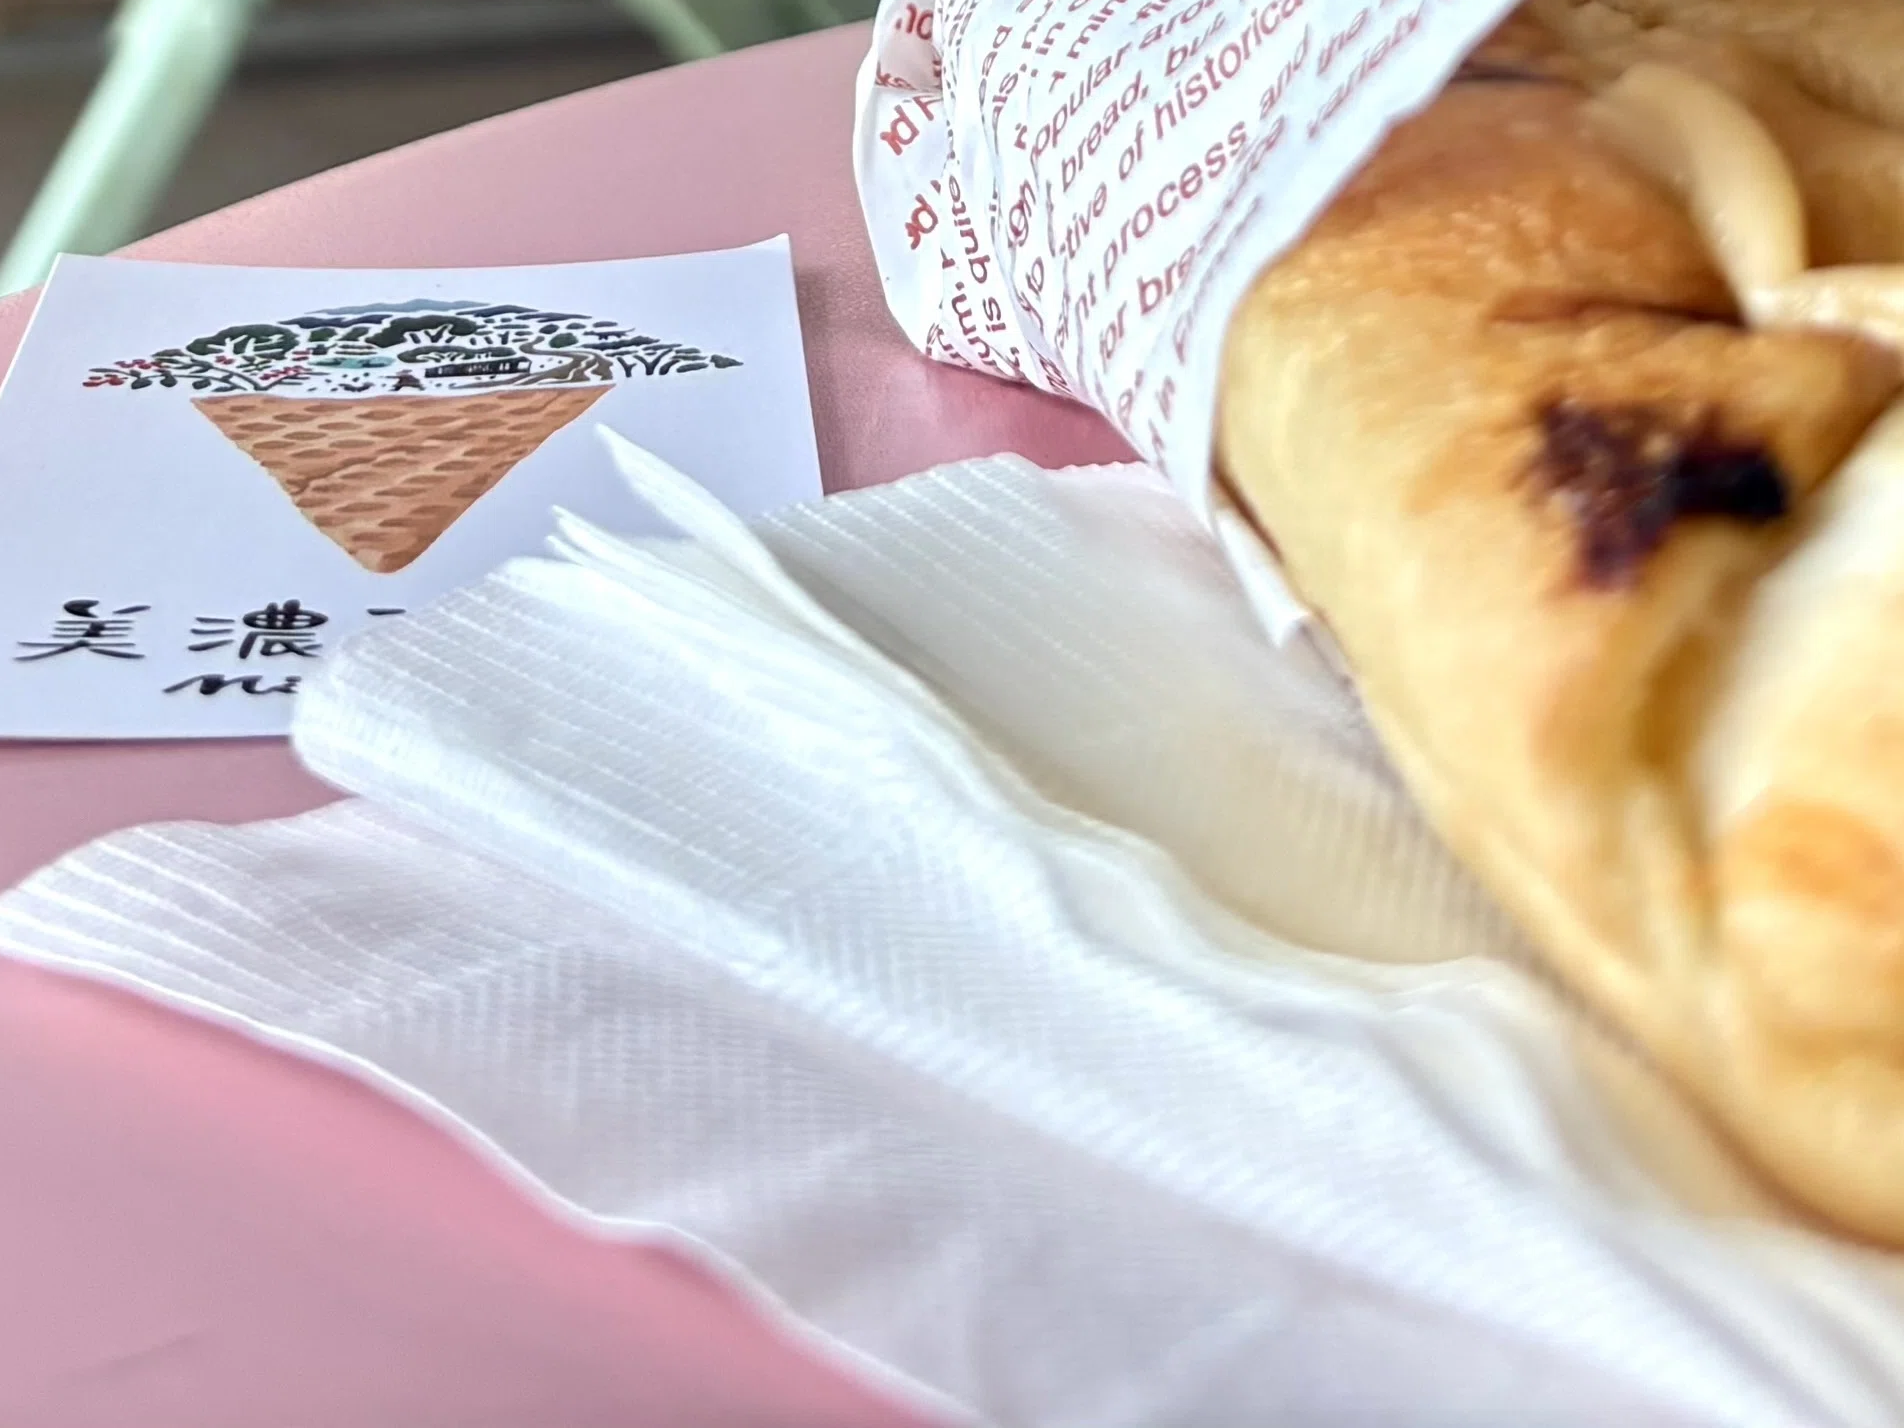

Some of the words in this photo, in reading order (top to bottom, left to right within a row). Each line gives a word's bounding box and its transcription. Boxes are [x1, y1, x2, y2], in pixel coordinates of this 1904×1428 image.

[1061, 69, 1150, 193] bread,
[1102, 120, 1248, 291] process
[1258, 21, 1312, 123] and
[1118, 118, 1146, 182] of
[949, 174, 991, 286] quite
[13, 598, 407, 662] 美濃
